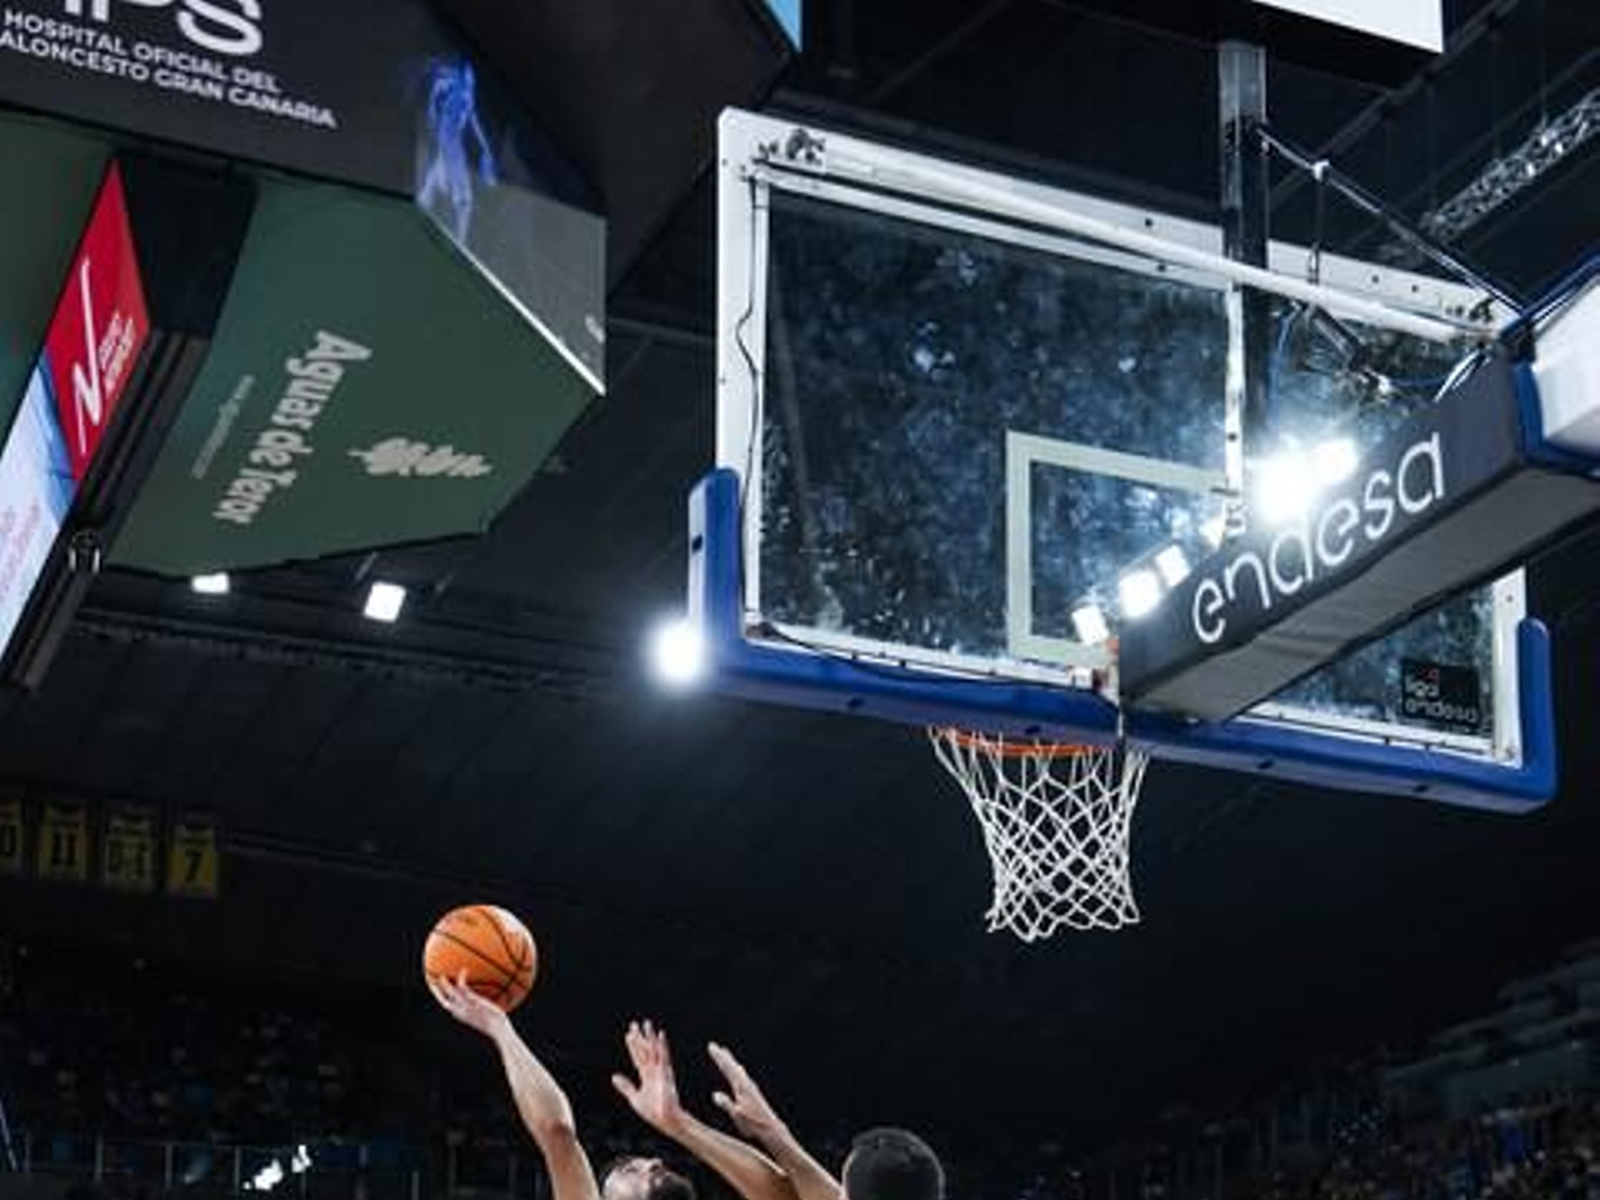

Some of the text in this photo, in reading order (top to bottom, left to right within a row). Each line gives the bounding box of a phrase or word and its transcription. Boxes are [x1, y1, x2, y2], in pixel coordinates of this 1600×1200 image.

[5, 9, 127, 56] HOSPITAL
[133, 41, 229, 82] OFICIAL
[233, 66, 282, 94] DEL
[154, 68, 224, 101] GRAN
[228, 87, 338, 130] CANARIA
[272, 330, 373, 430] Aguas
[249, 429, 314, 467] de
[1192, 432, 1445, 643] endesa
